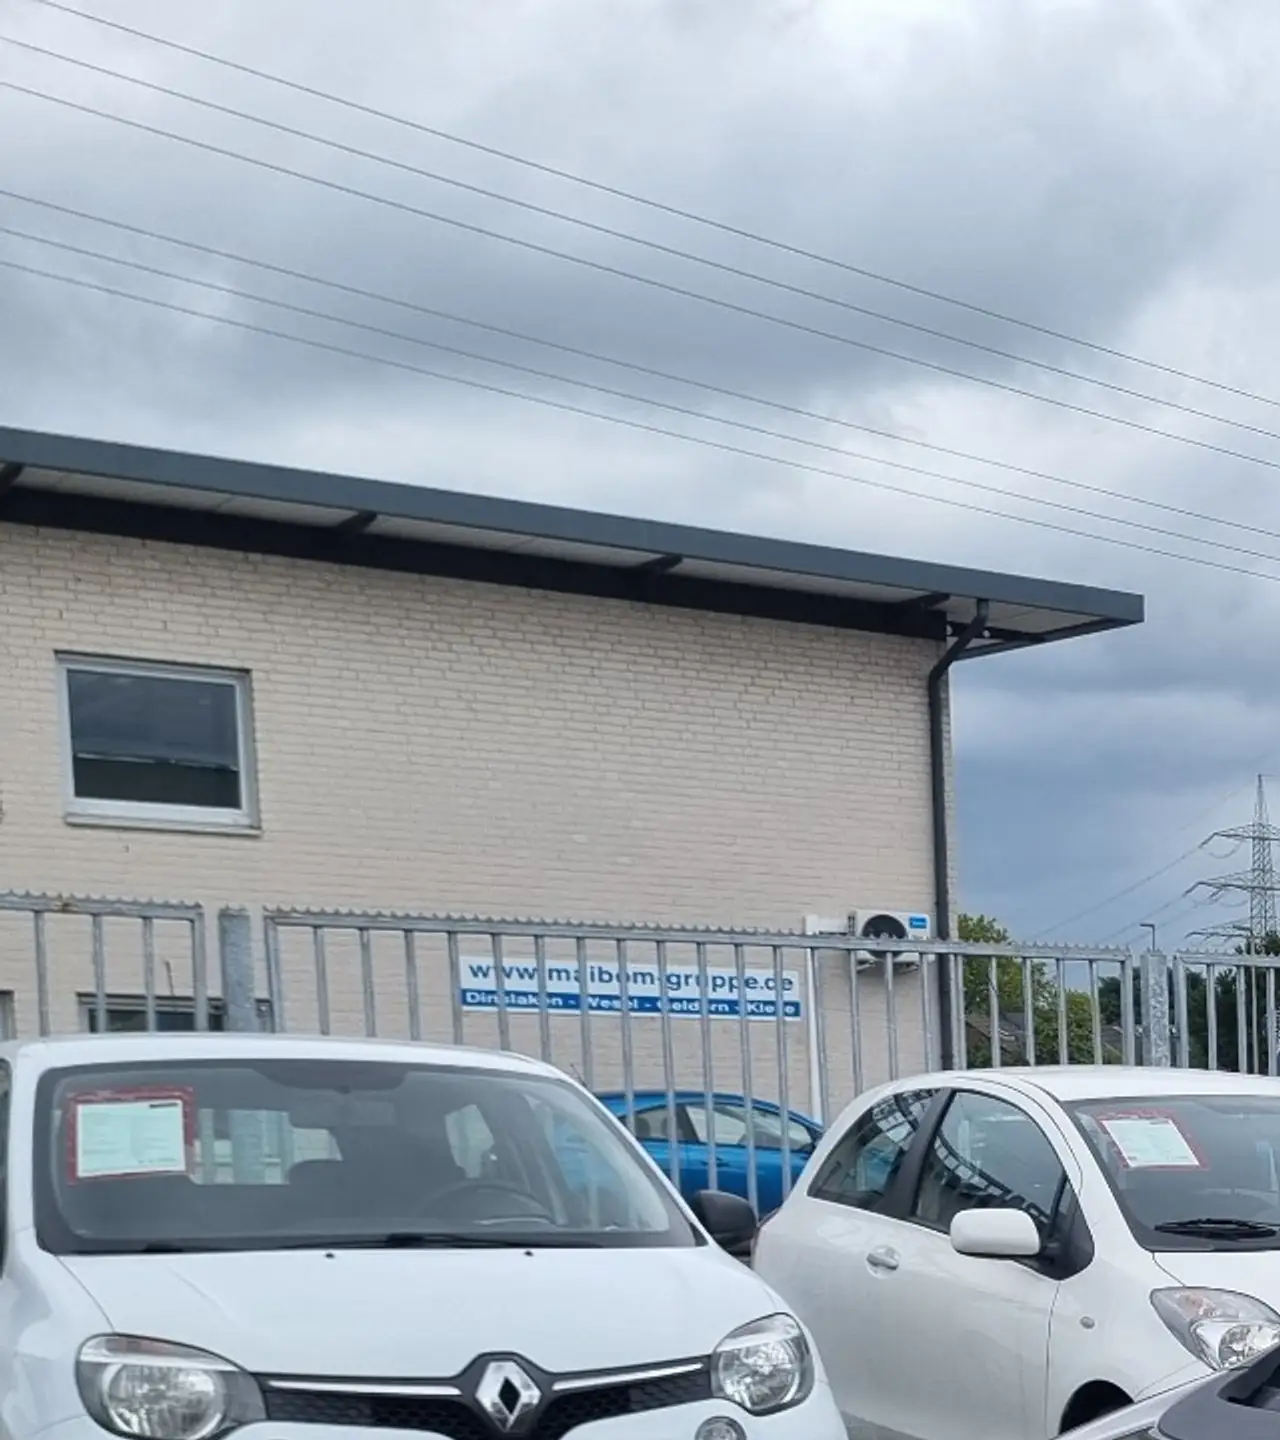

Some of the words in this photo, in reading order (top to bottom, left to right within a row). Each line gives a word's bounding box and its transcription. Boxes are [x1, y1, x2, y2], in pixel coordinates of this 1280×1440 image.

[469, 963, 793, 992] wwwmibomgrppe.de
[465, 991, 563, 1006] Dinlakn
[656, 999, 729, 1012] eldrn
[746, 1002, 795, 1014] Klee
